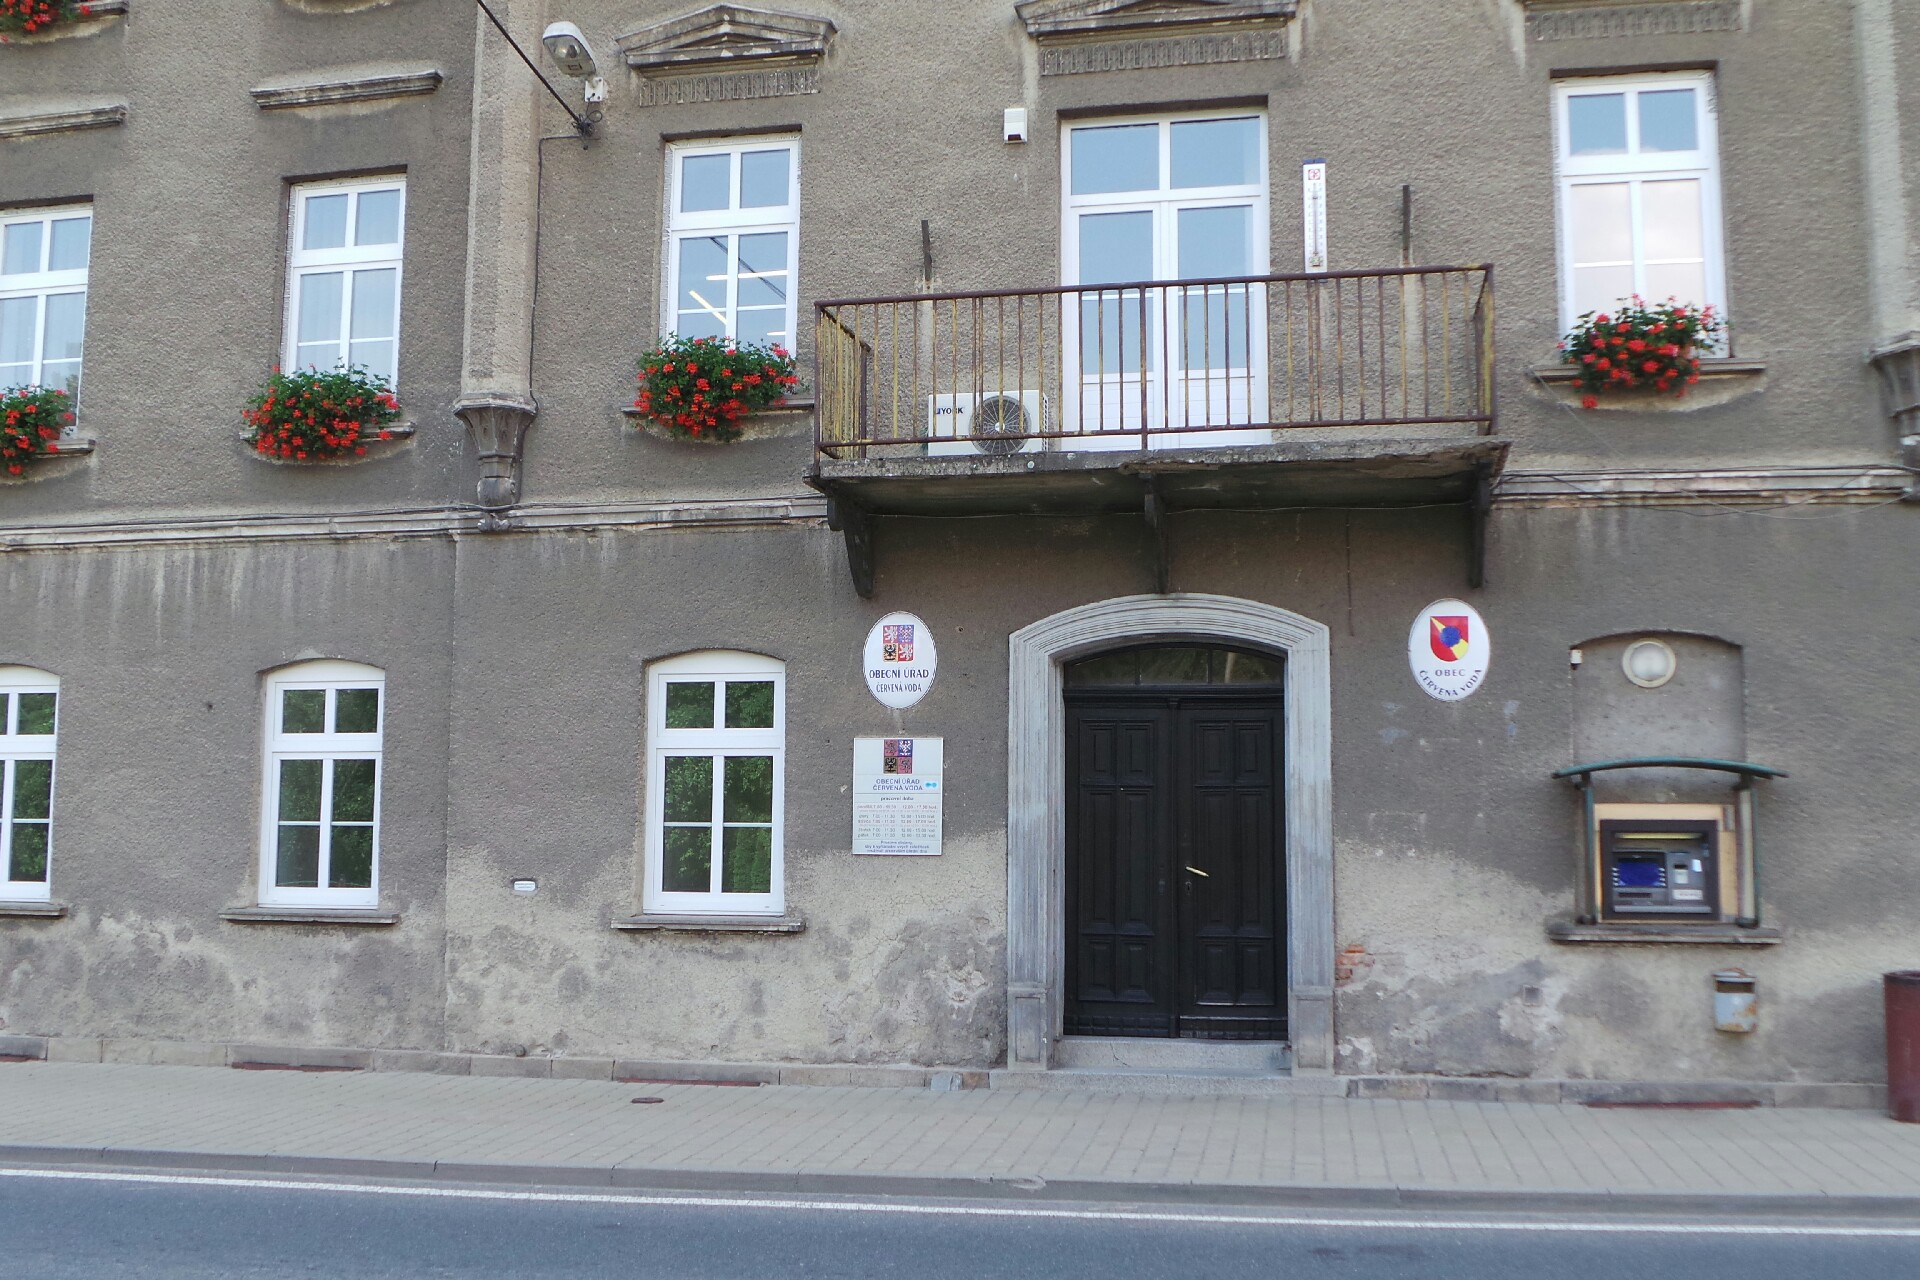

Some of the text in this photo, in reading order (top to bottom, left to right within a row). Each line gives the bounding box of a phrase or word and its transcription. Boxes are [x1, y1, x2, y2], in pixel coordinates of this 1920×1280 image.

[869, 667, 929, 679] OBECNÍ ÚŘAD
[1460, 669, 1482, 691] VODA
[876, 681, 922, 693] ČERVENÁ VODA
[875, 777, 900, 785] OBECNÍ
